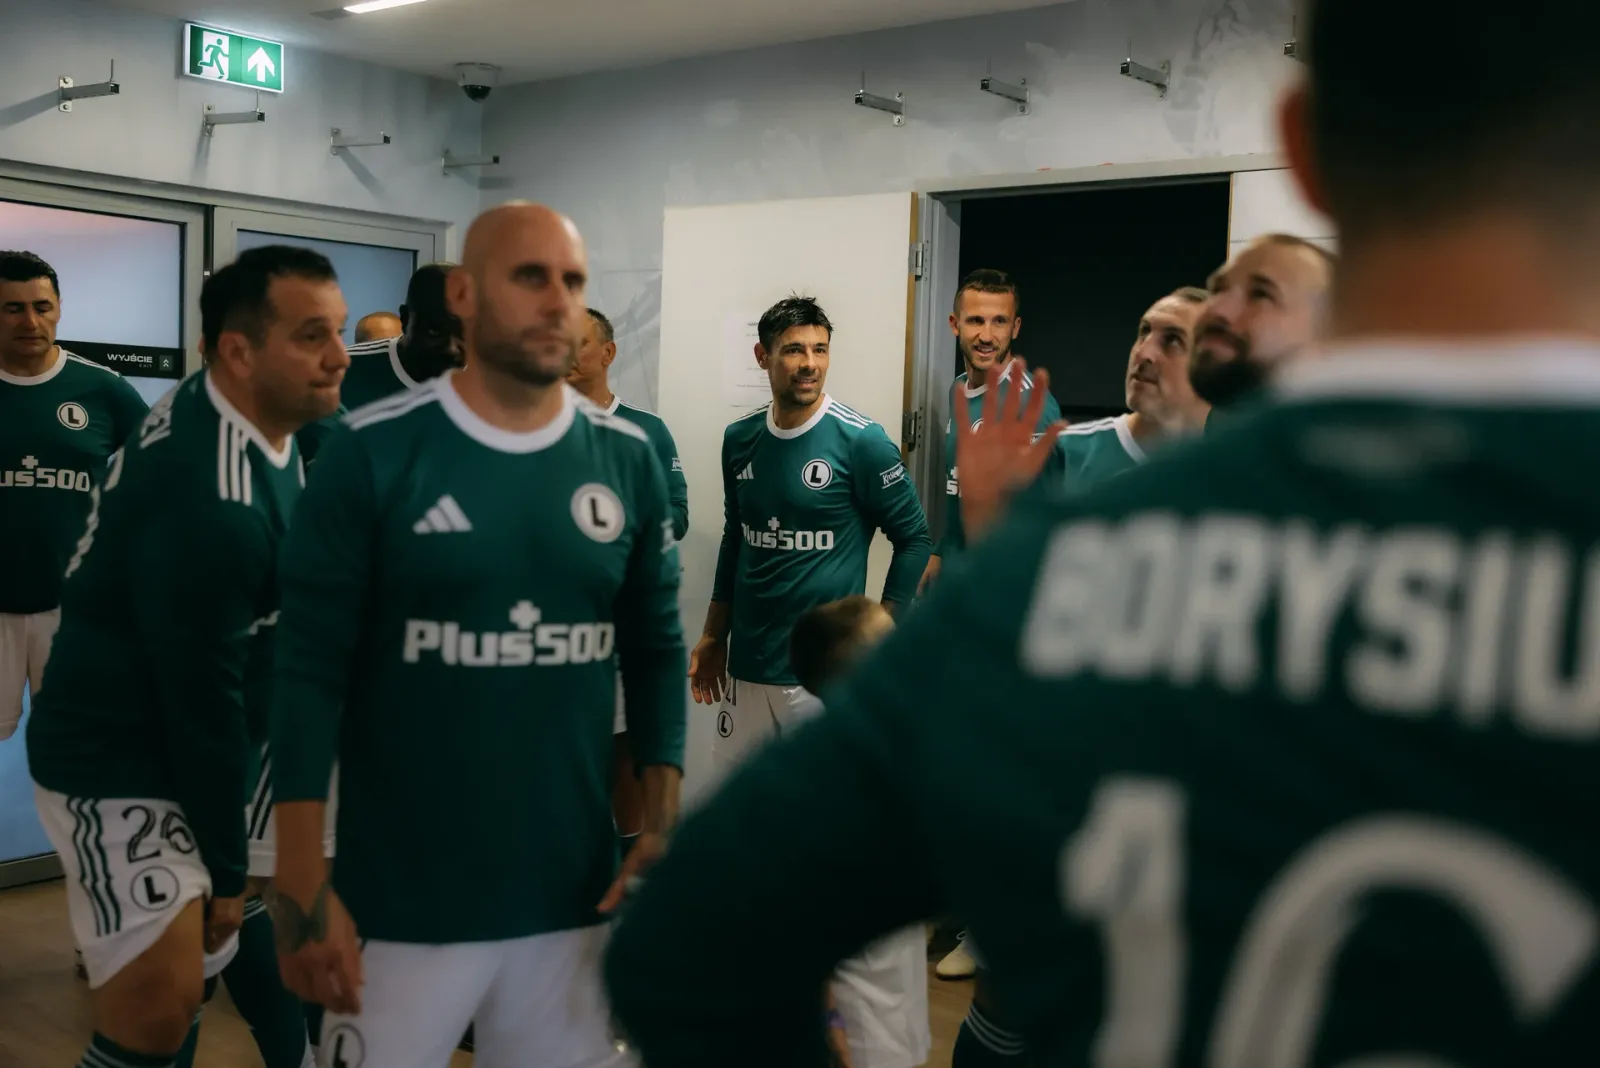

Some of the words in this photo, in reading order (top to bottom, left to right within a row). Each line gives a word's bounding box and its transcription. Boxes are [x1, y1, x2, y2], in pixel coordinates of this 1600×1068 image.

[106, 353, 153, 363] WYJŚCIE
[403, 618, 615, 667] Plus500
[122, 805, 197, 863] 26
